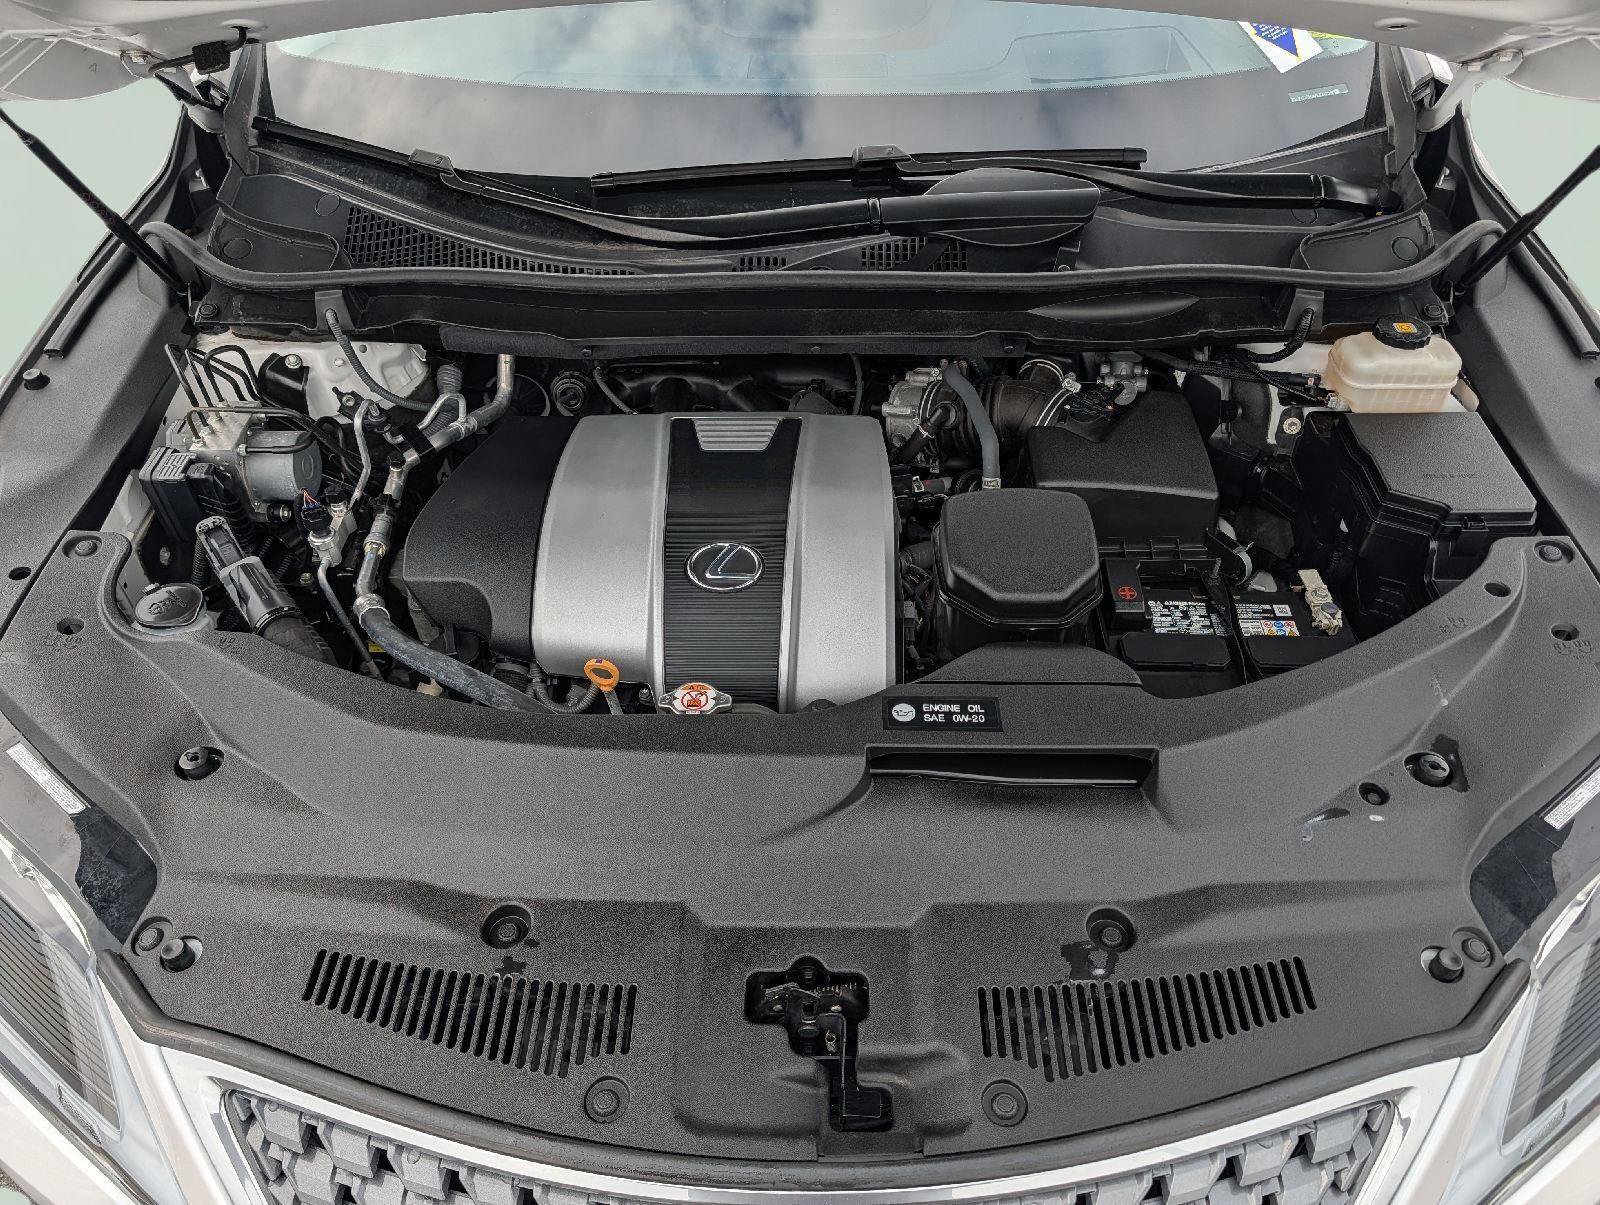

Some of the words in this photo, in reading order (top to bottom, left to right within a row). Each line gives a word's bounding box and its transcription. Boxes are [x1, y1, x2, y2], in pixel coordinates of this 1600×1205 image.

[922, 703, 961, 713] ENGINE
[967, 704, 985, 713] OIL
[923, 713, 946, 722] SAE
[952, 714, 985, 723] 0W-20
